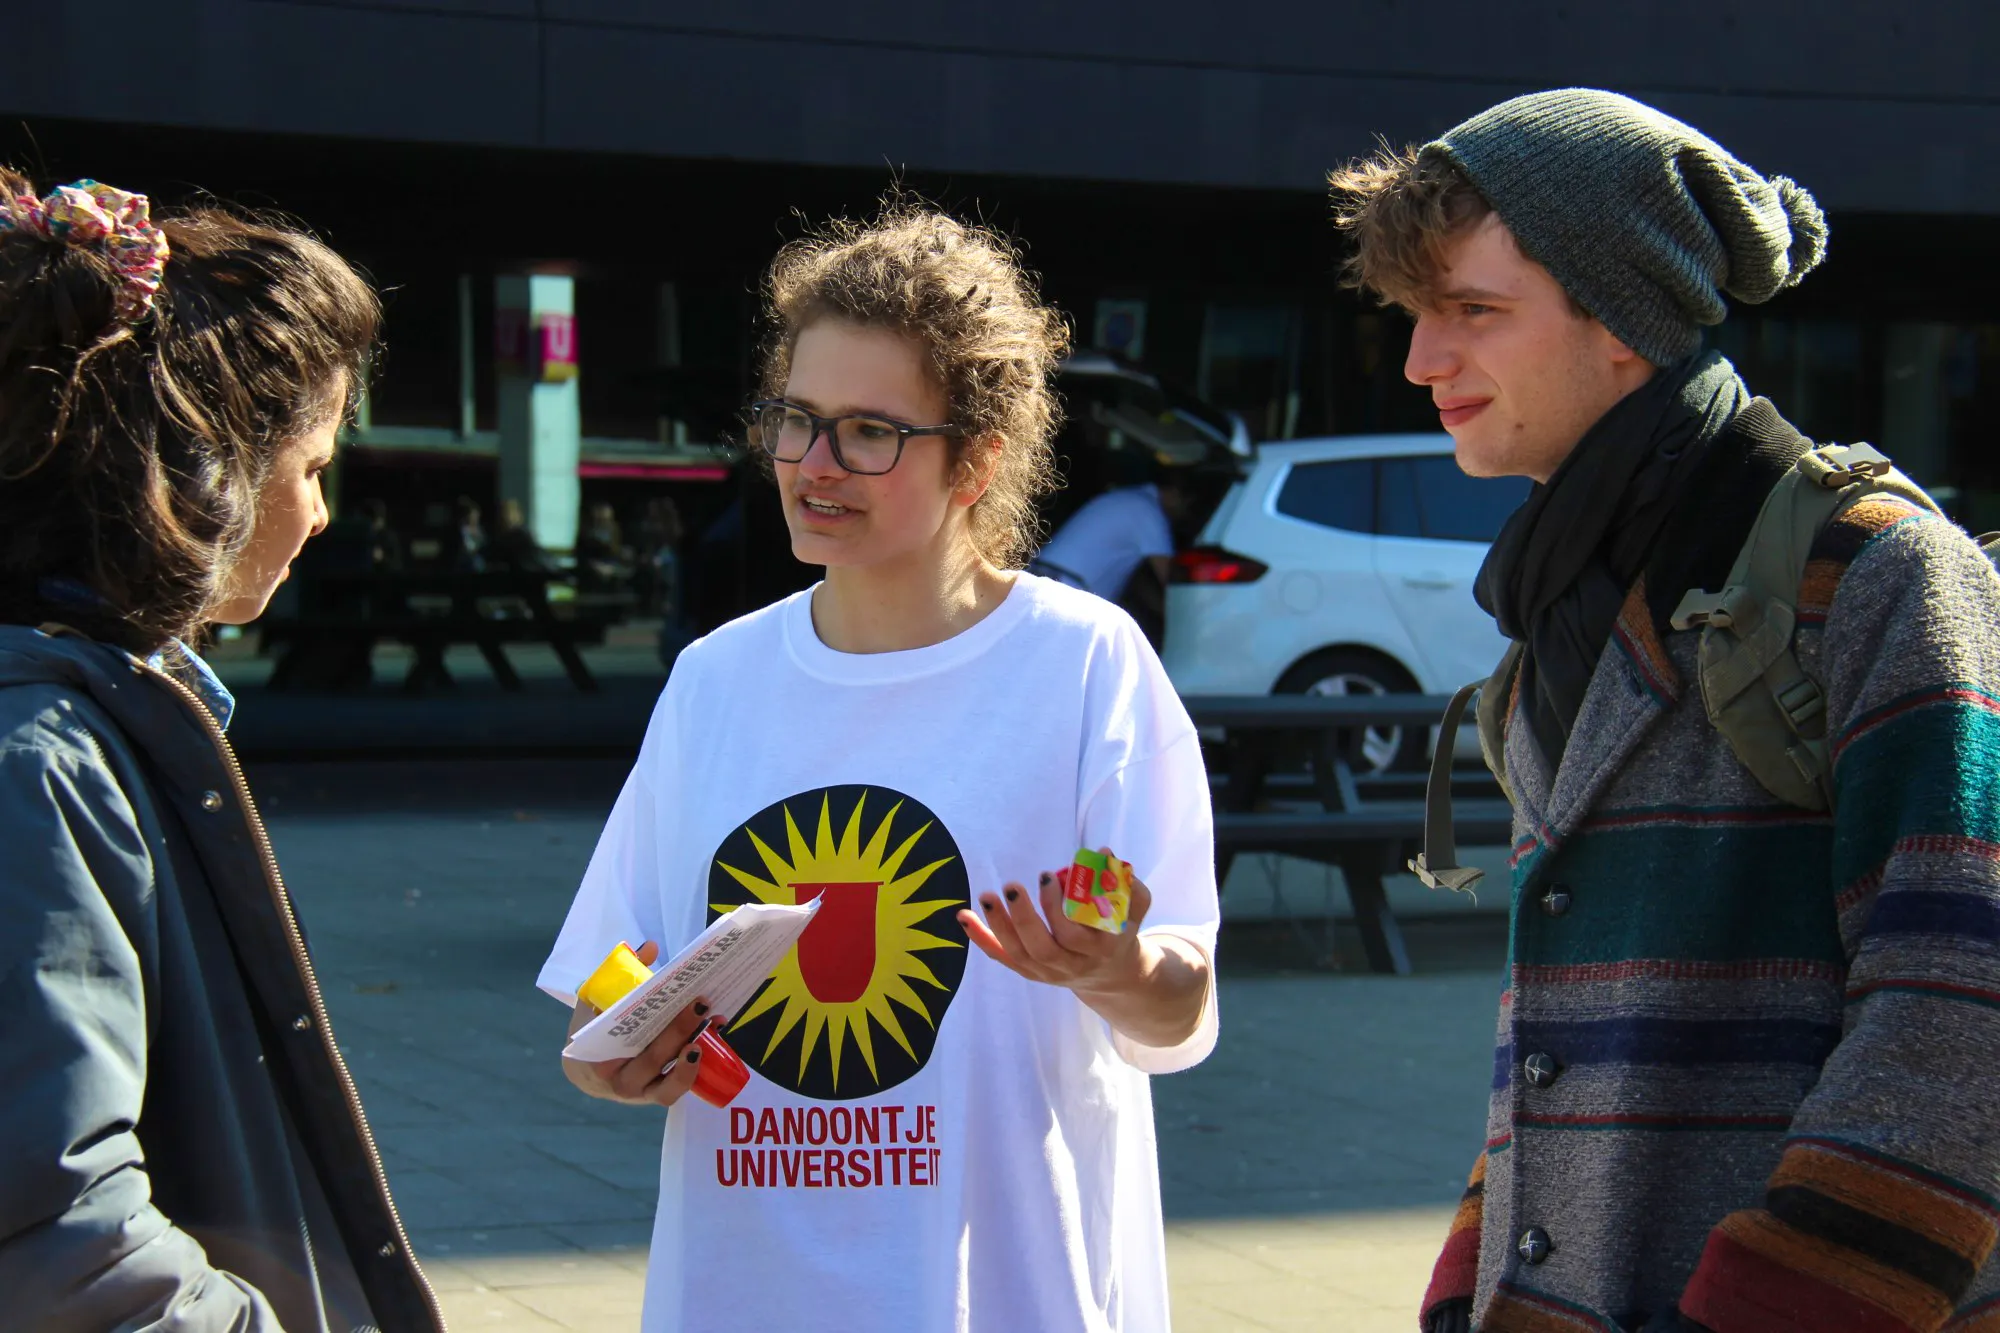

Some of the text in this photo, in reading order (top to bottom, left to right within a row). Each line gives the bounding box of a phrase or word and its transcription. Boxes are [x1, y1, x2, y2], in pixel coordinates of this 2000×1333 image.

[673, 951, 713, 981] RED
[730, 1105, 936, 1145] DANOONTJE
[716, 1148, 941, 1188] UNIVERSITEIT
